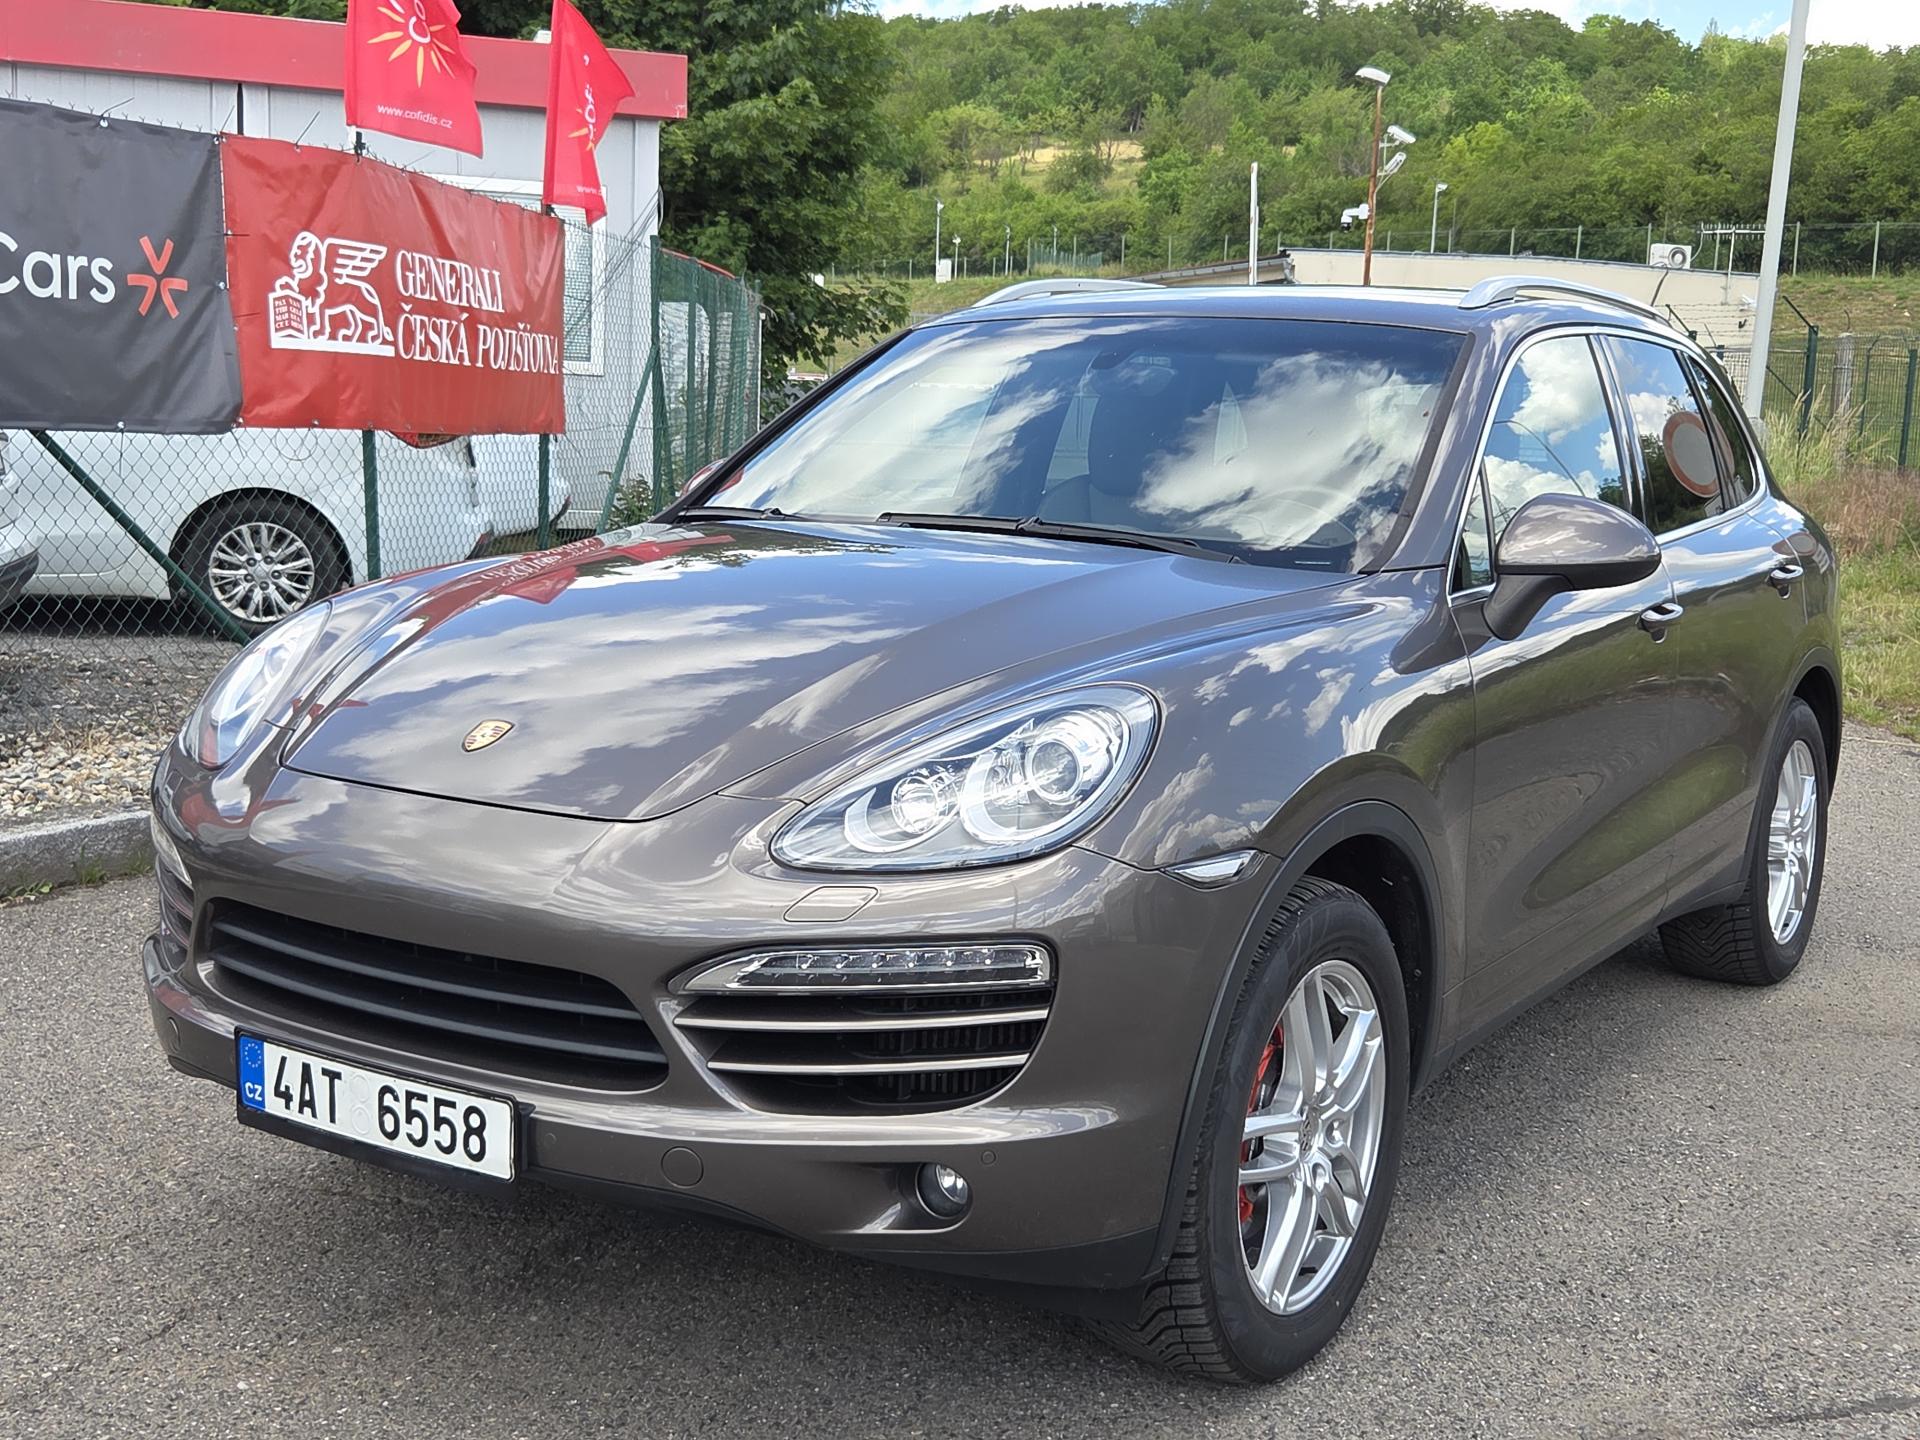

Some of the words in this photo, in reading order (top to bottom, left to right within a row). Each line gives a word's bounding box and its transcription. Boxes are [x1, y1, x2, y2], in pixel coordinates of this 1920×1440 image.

[377, 104, 453, 129] www.cofidis.cz
[395, 249, 505, 313] GENERALI
[398, 302, 472, 367] ČESKÁ
[244, 1081, 263, 1101] CZ
[273, 1055, 343, 1125] 4AT
[377, 1084, 487, 1163] 6558
